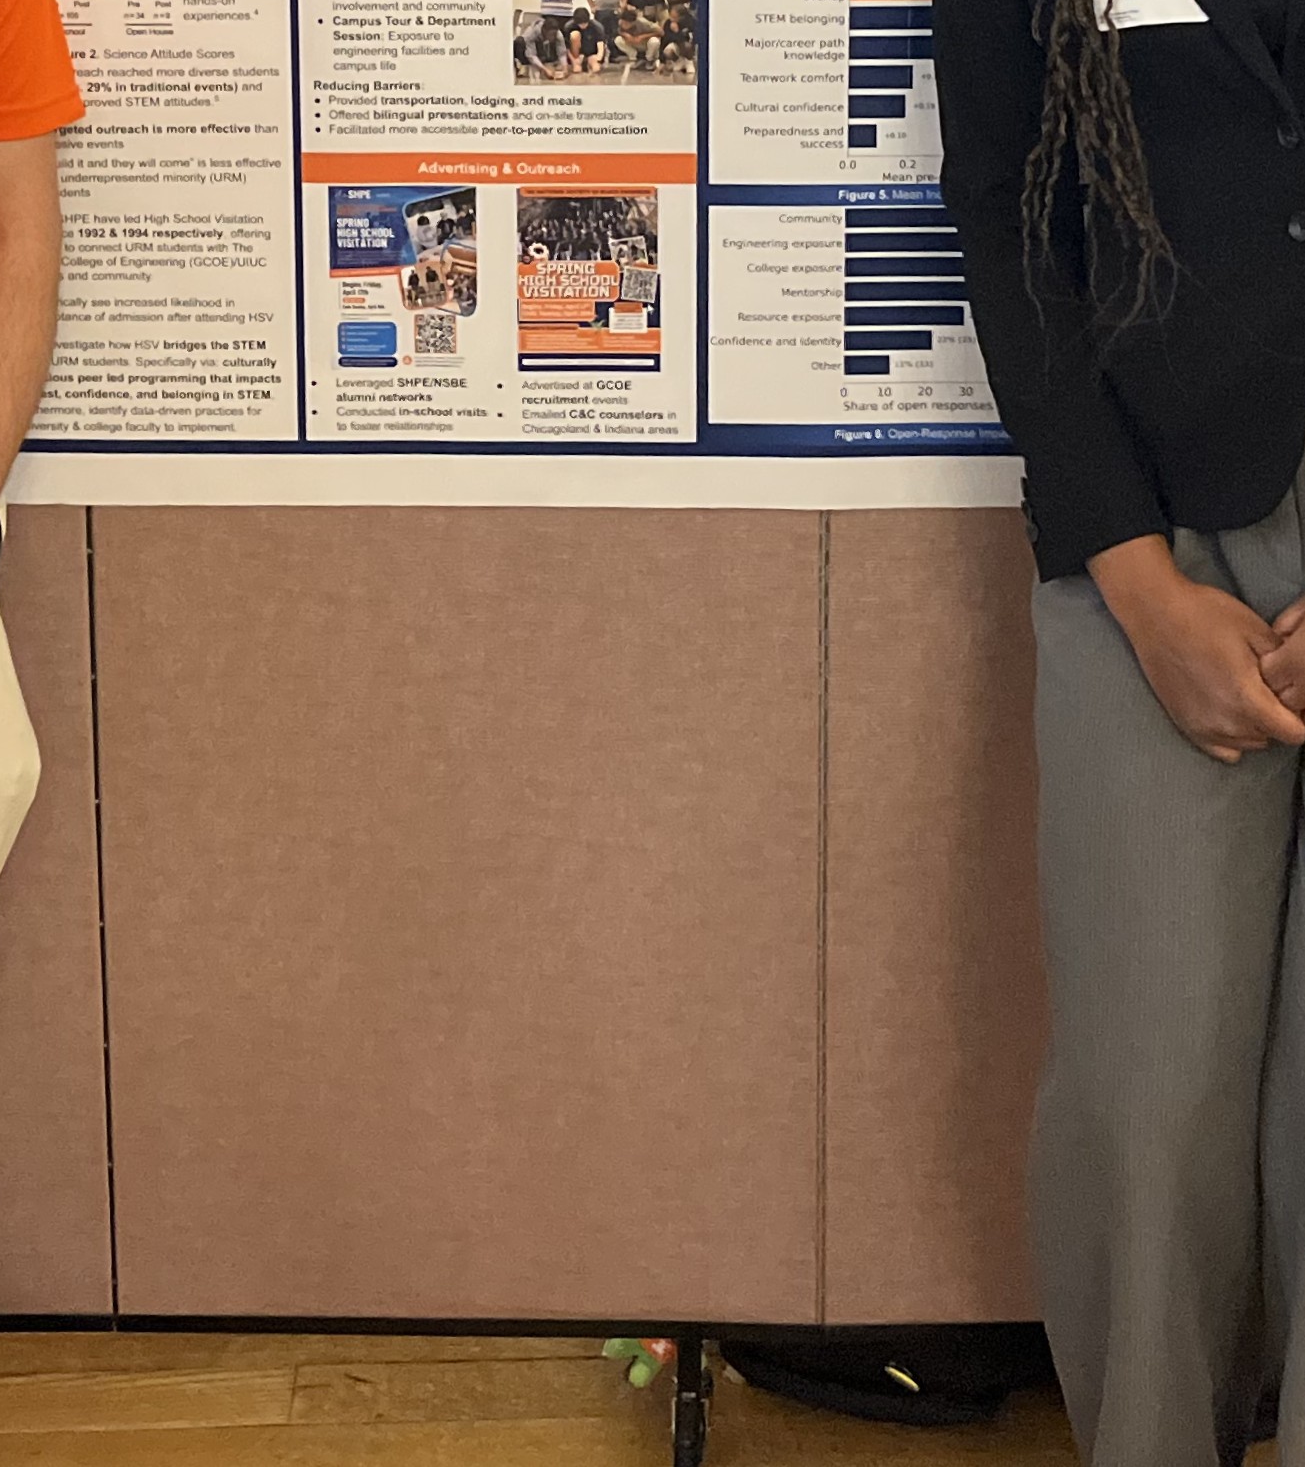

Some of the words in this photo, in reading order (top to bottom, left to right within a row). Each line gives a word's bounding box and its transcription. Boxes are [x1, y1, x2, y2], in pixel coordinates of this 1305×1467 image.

[313, 79, 371, 95] Reducing
[734, 102, 780, 113] Cultural
[782, 101, 845, 113] confidence
[417, 161, 499, 178] Advertising
[501, 161, 514, 175] &
[516, 161, 582, 175] Outreach
[535, 263, 596, 275] SPRING
[518, 274, 556, 287] HIGH
[558, 274, 619, 287] SCHOOL
[522, 286, 611, 299] VISITATION
